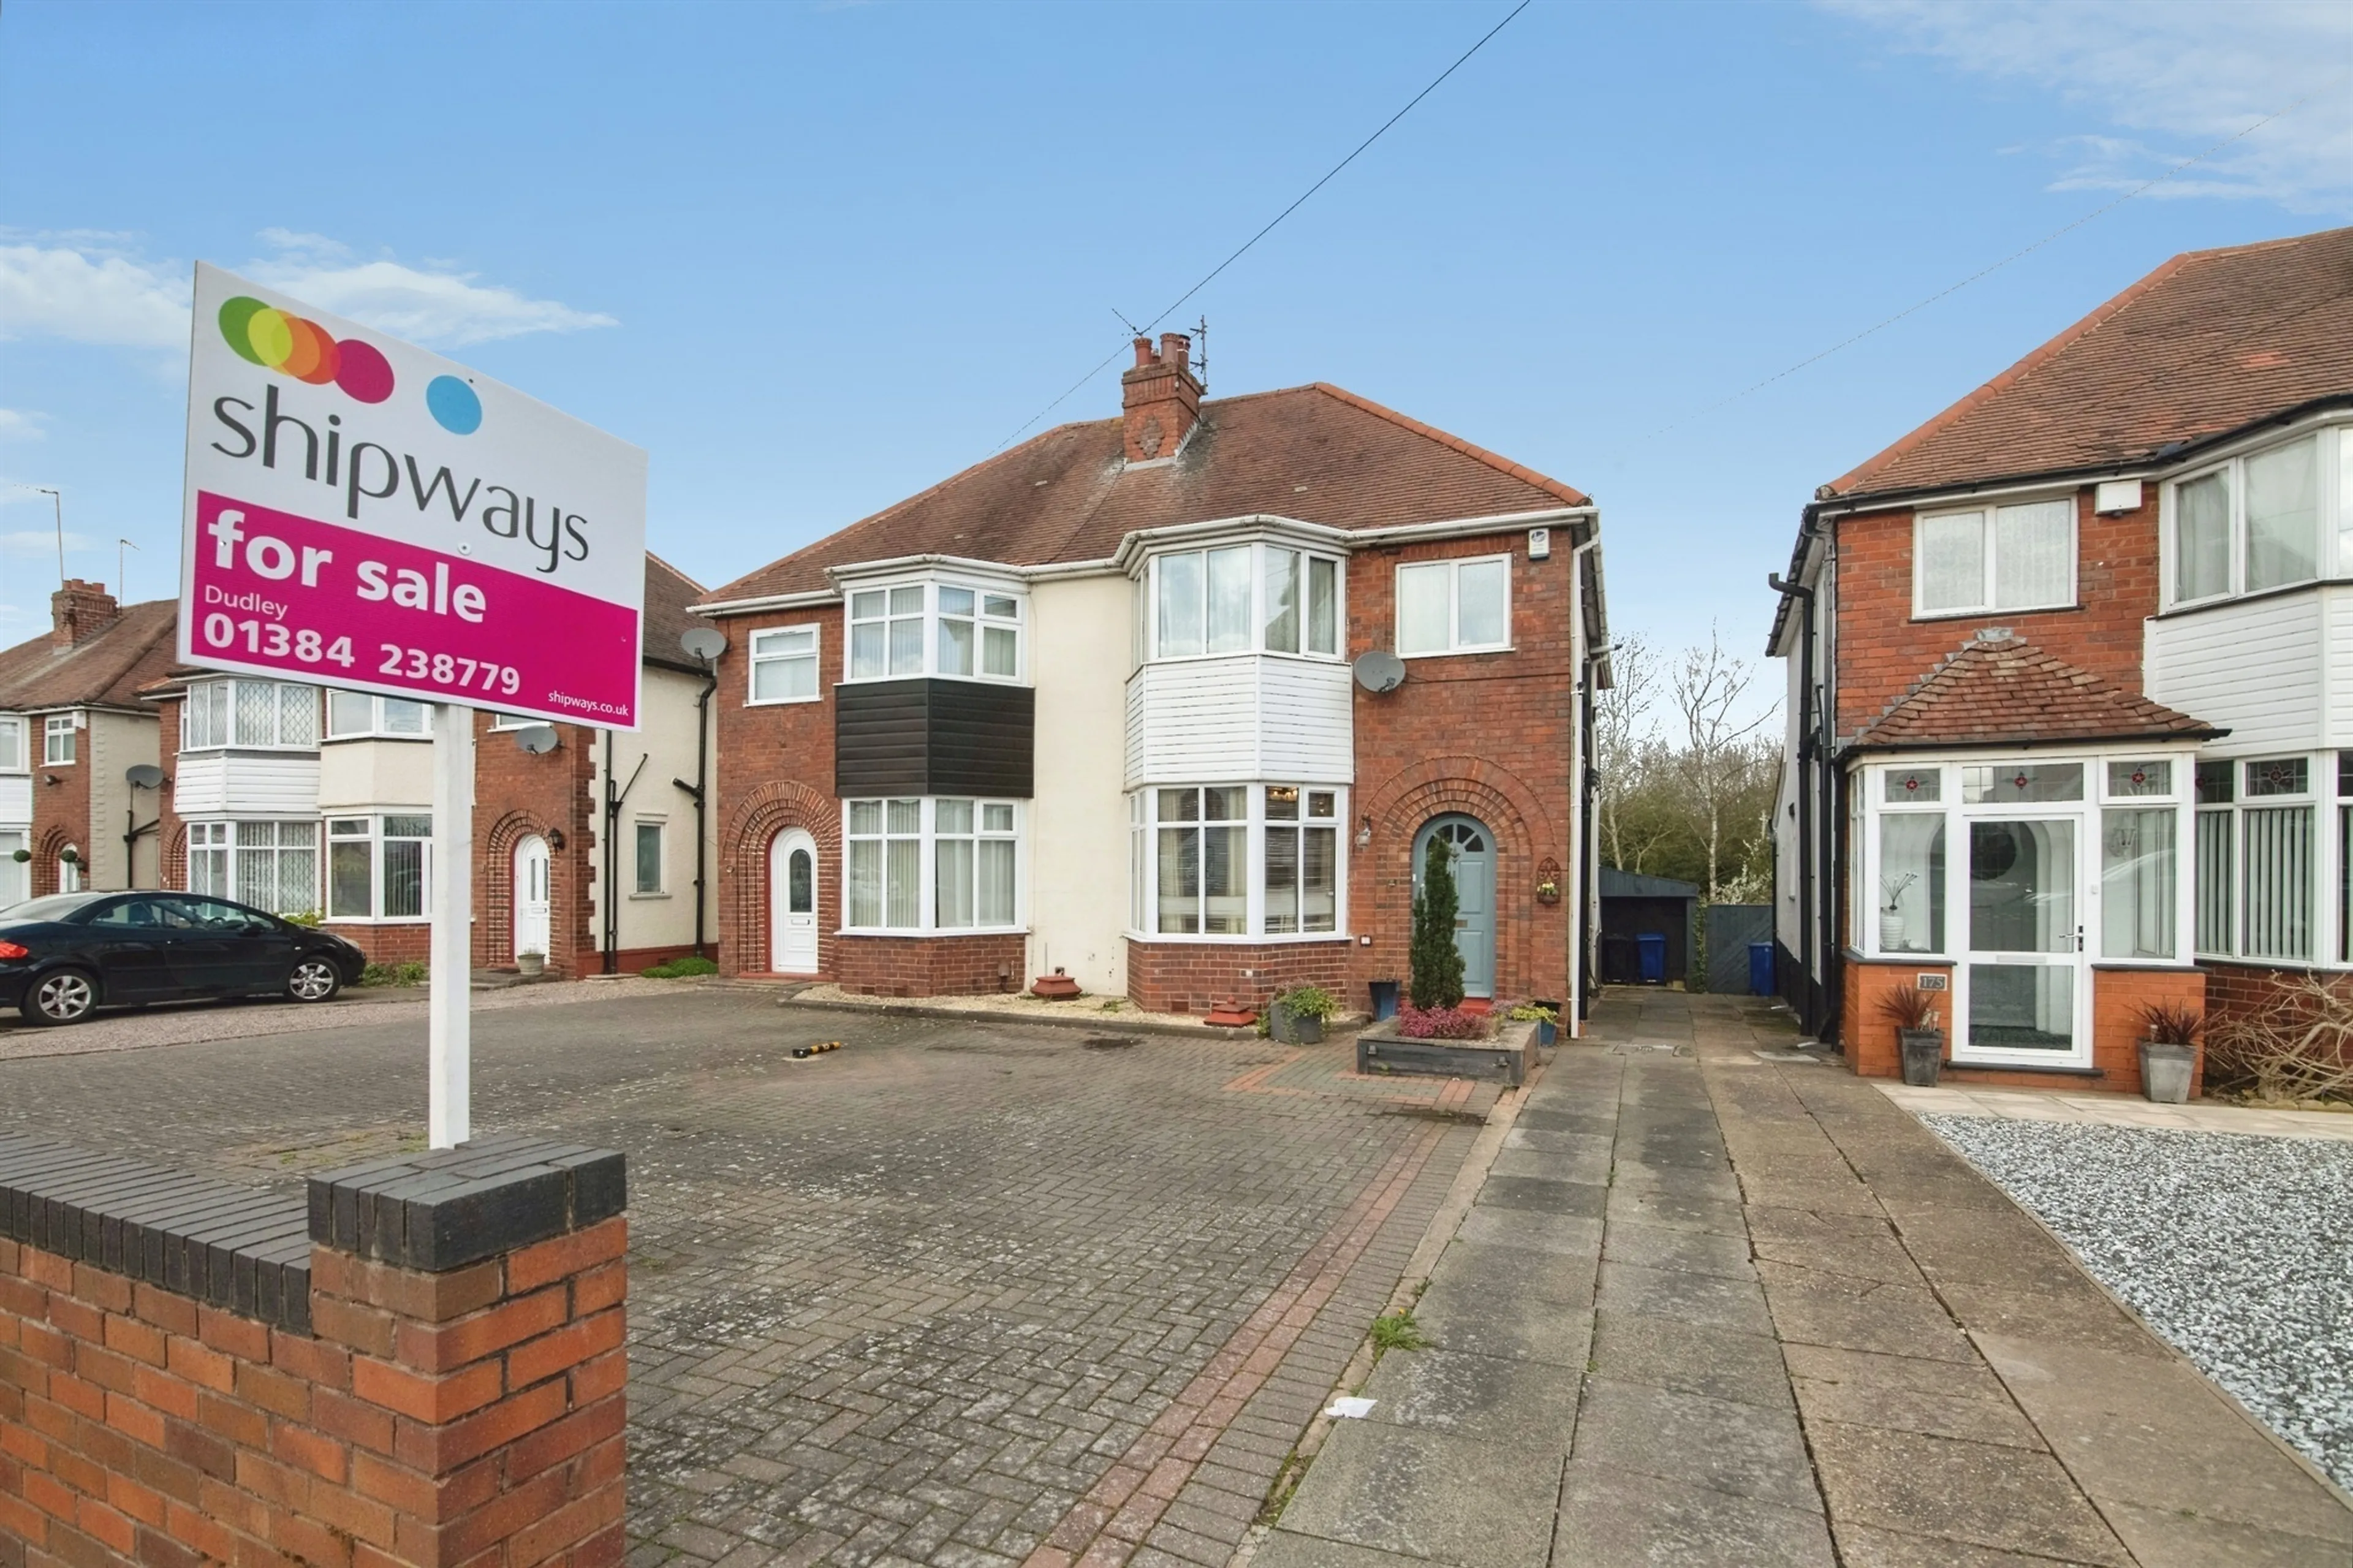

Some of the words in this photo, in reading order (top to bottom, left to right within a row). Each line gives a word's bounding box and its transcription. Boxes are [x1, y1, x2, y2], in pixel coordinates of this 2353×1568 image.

[210, 384, 589, 574] shipways
[208, 509, 333, 588] for
[357, 560, 487, 623] sale
[205, 584, 288, 621] Dudley
[204, 613, 355, 668] 01384
[379, 643, 520, 695] 238779
[548, 690, 629, 716] shipways.co.uk
[1922, 977, 1944, 988] 175
